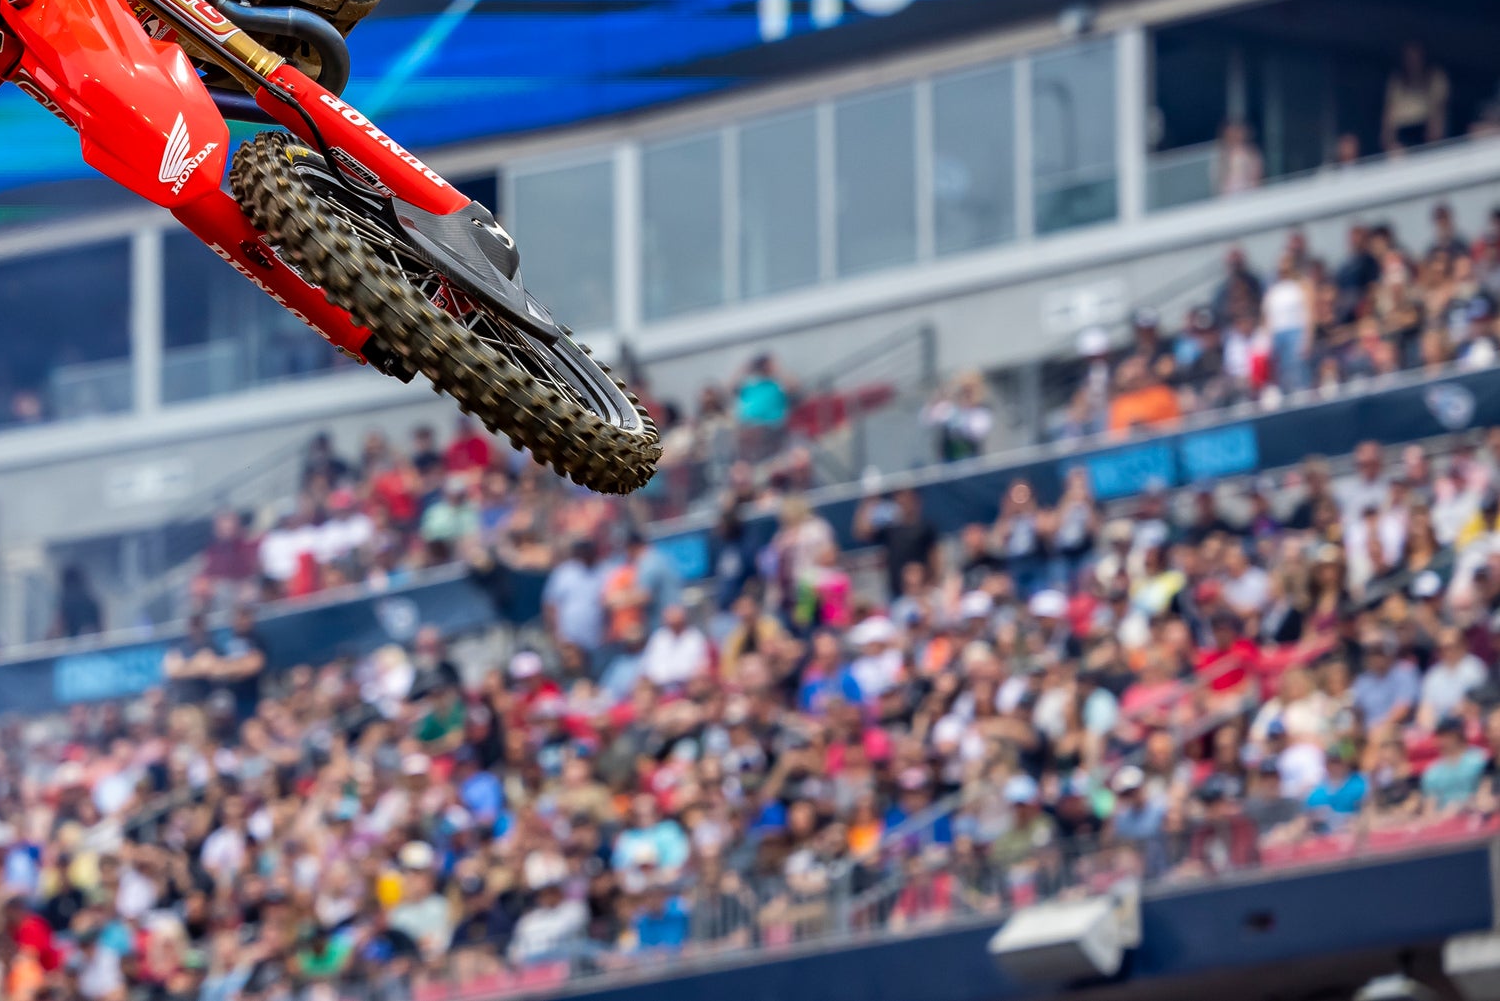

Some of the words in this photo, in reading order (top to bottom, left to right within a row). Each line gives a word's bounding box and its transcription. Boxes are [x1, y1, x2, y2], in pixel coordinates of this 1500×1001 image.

[171, 142, 219, 195] HONDA
[319, 94, 448, 187] DUNLOP
[206, 241, 331, 339] DUNLOP
